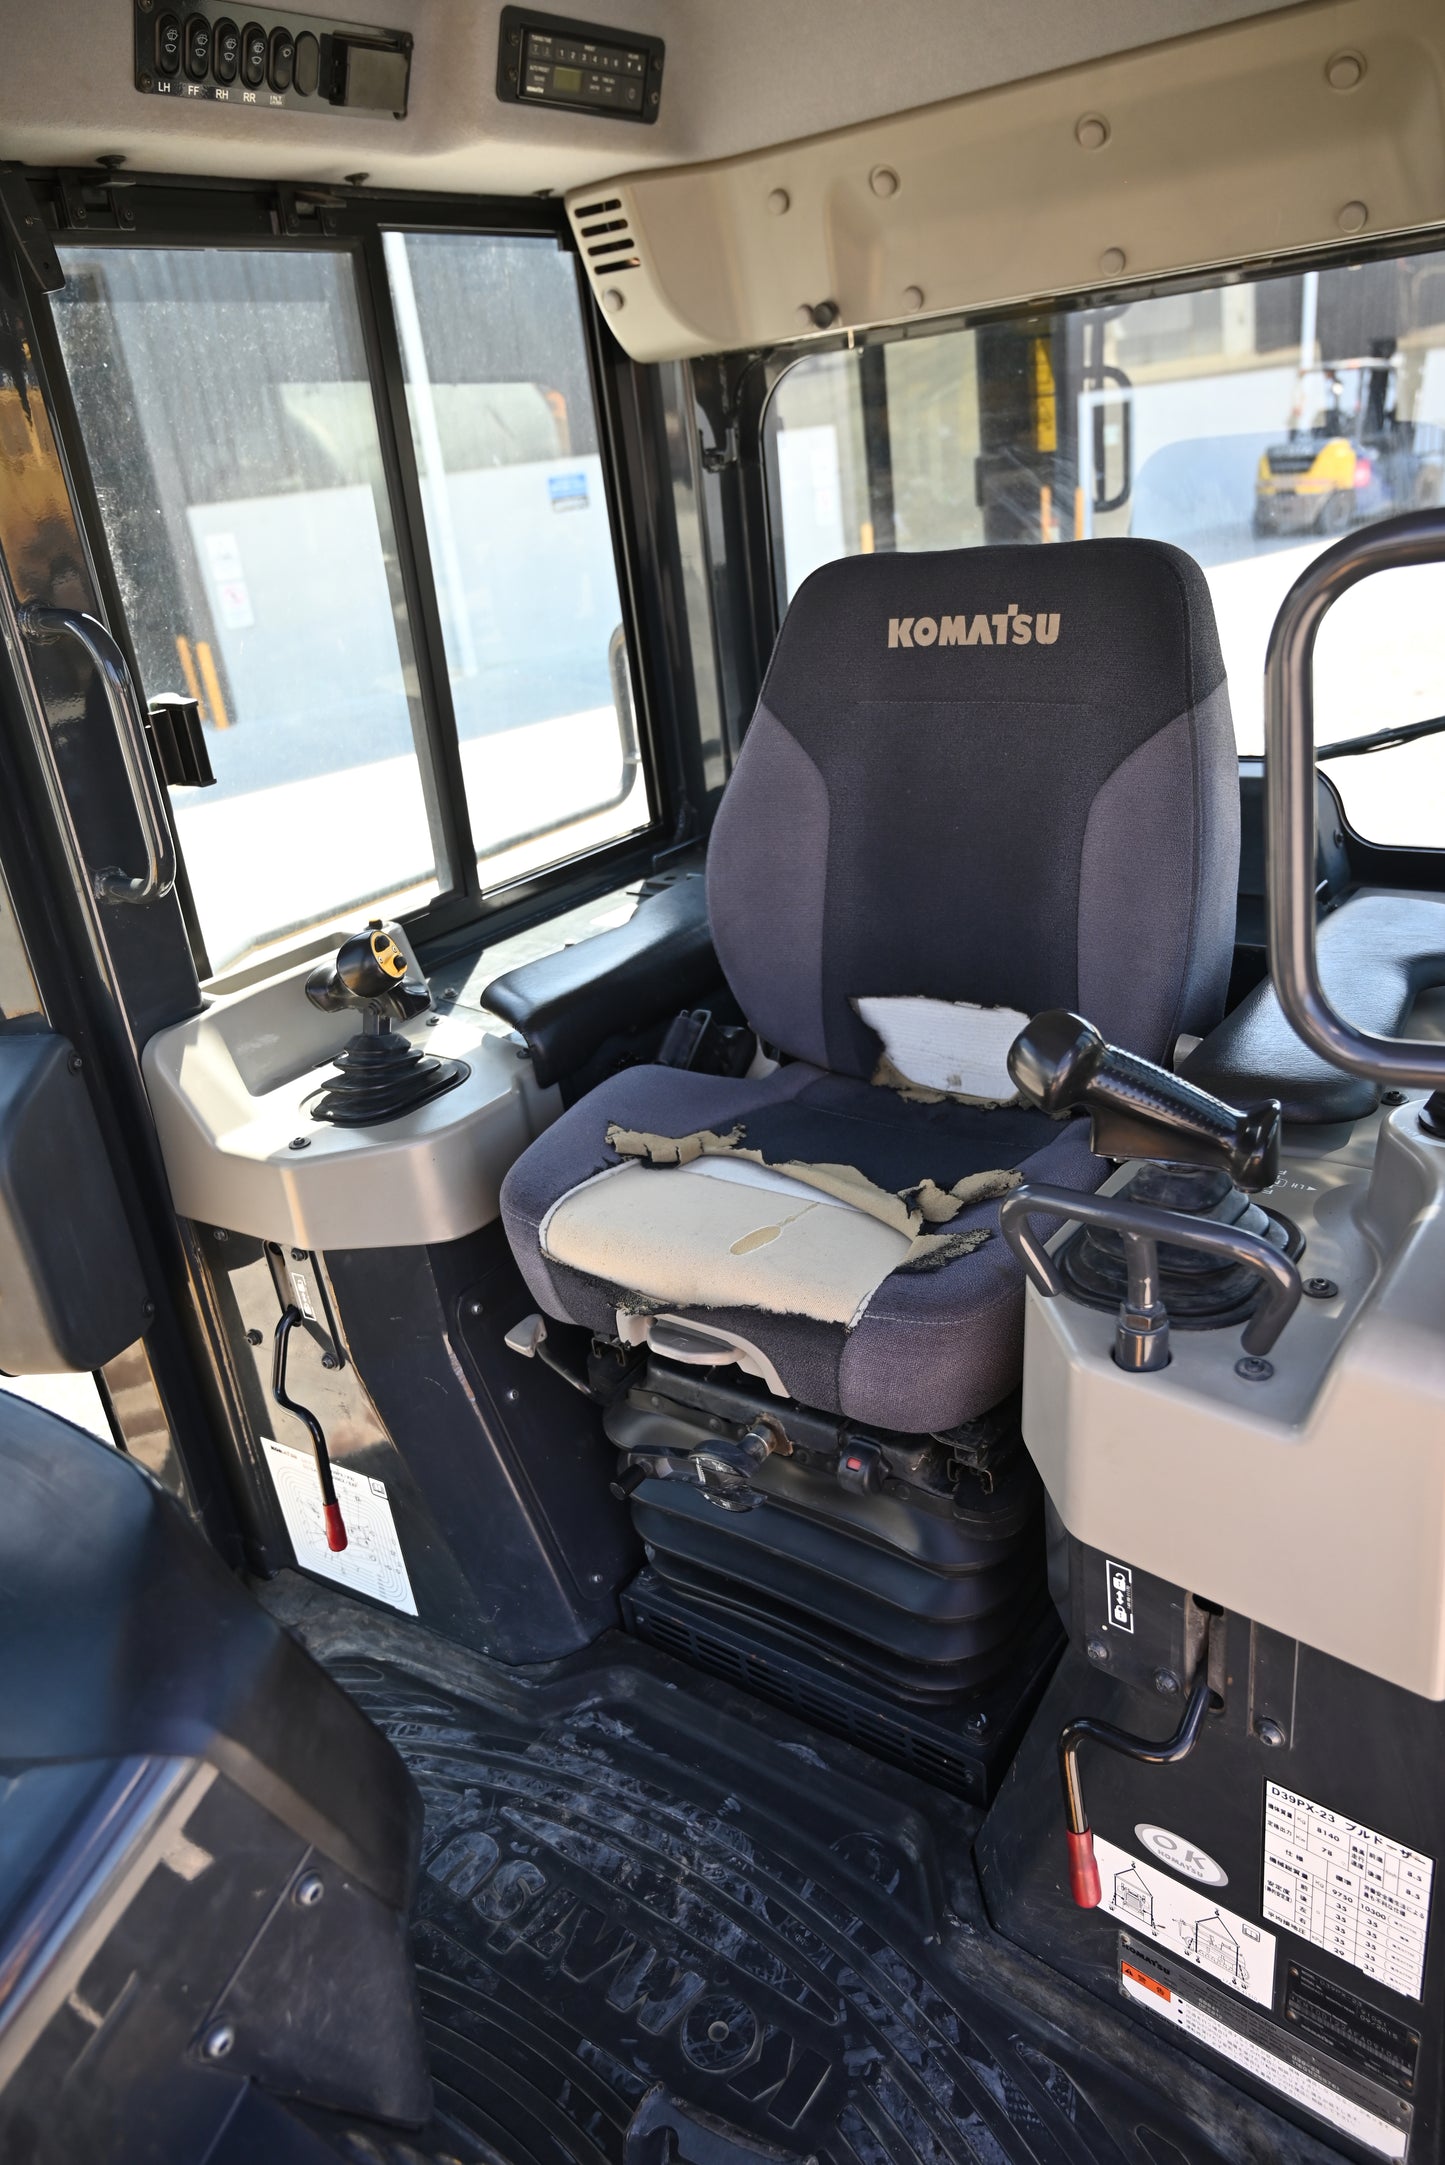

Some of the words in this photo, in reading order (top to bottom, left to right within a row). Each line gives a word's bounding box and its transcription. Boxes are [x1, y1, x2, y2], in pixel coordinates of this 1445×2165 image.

[158, 81, 171, 92] LH
[188, 85, 200, 96] FF
[215, 89, 229, 100] RH
[243, 92, 256, 103] RR
[888, 604, 1061, 648] KOMATSU
[1272, 1787, 1335, 1822] D39PX-23
[1345, 1822, 1426, 1867] ブルドーザー
[1317, 1827, 1339, 1841] 8140
[1321, 1847, 1332, 1856] 78
[1158, 1849, 1204, 1878] KOMATSU
[1336, 1903, 1347, 1912] 35
[1361, 1903, 1386, 1920] 10300
[1336, 1914, 1346, 1923] 35
[1367, 1919, 1378, 1927] 35
[1335, 1925, 1345, 1934] 35
[1366, 1930, 1377, 1939] 35
[1334, 1936, 1345, 1945] 35
[1365, 1941, 1376, 1950] 35
[1334, 1948, 1344, 1956] 29
[1364, 1952, 1375, 1961] 35
[427, 1831, 832, 2129] KOMATSU
